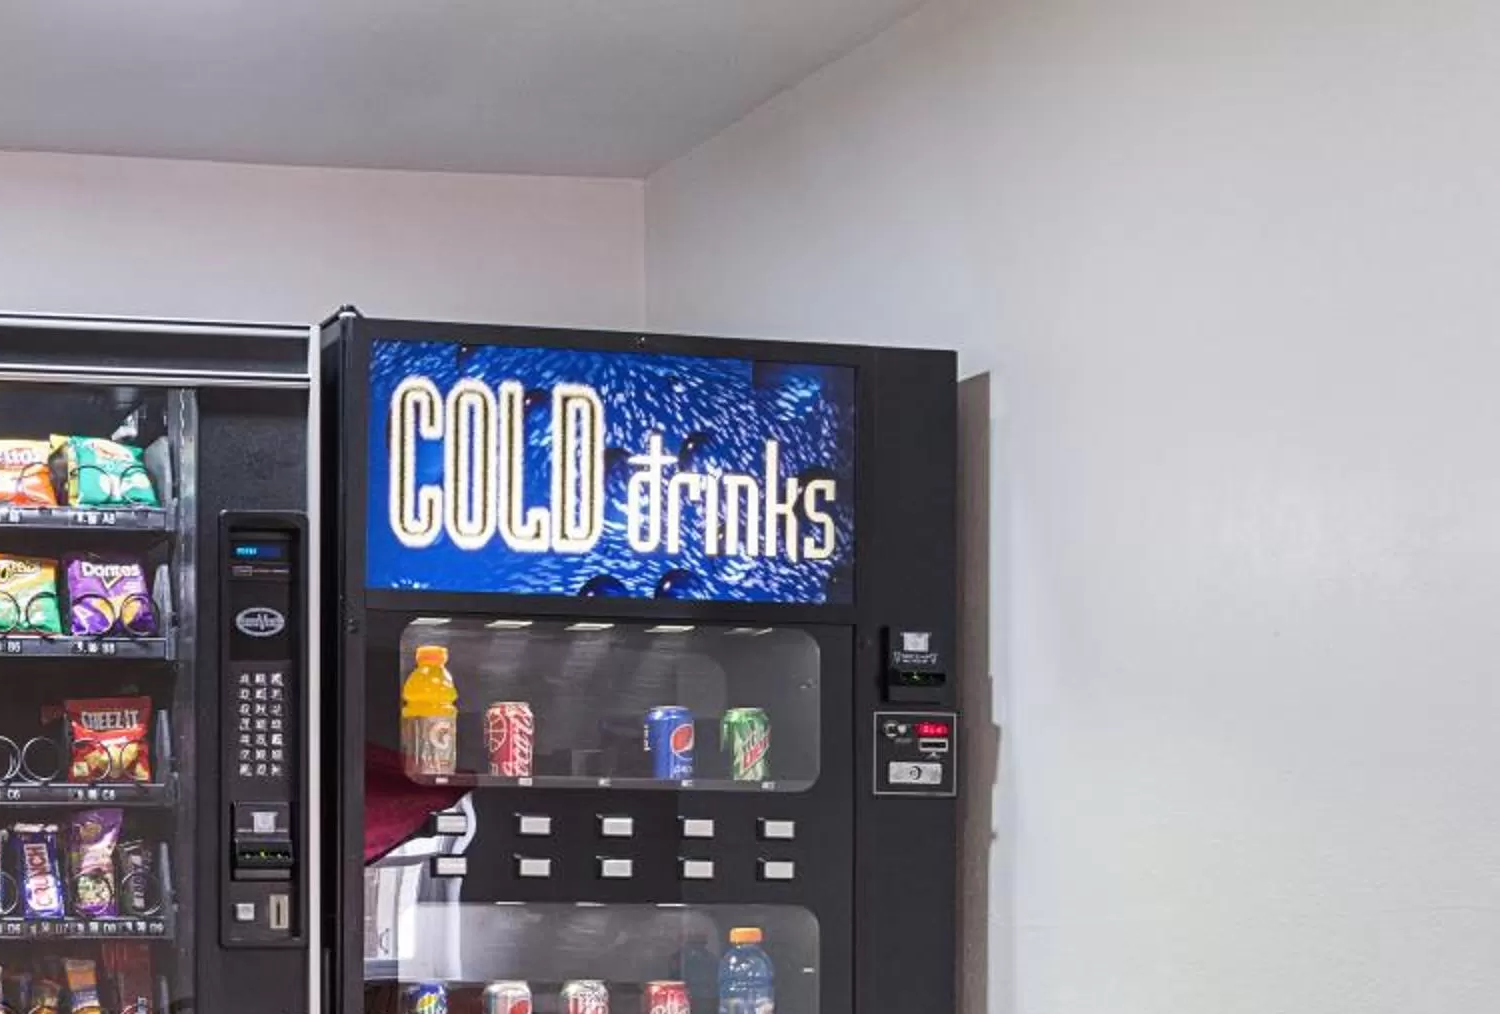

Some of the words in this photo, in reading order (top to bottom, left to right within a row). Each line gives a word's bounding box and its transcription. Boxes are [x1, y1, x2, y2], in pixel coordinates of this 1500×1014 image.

[388, 375, 606, 553] COLD
[627, 431, 837, 564] drinks
[81, 560, 141, 578] Doritos
